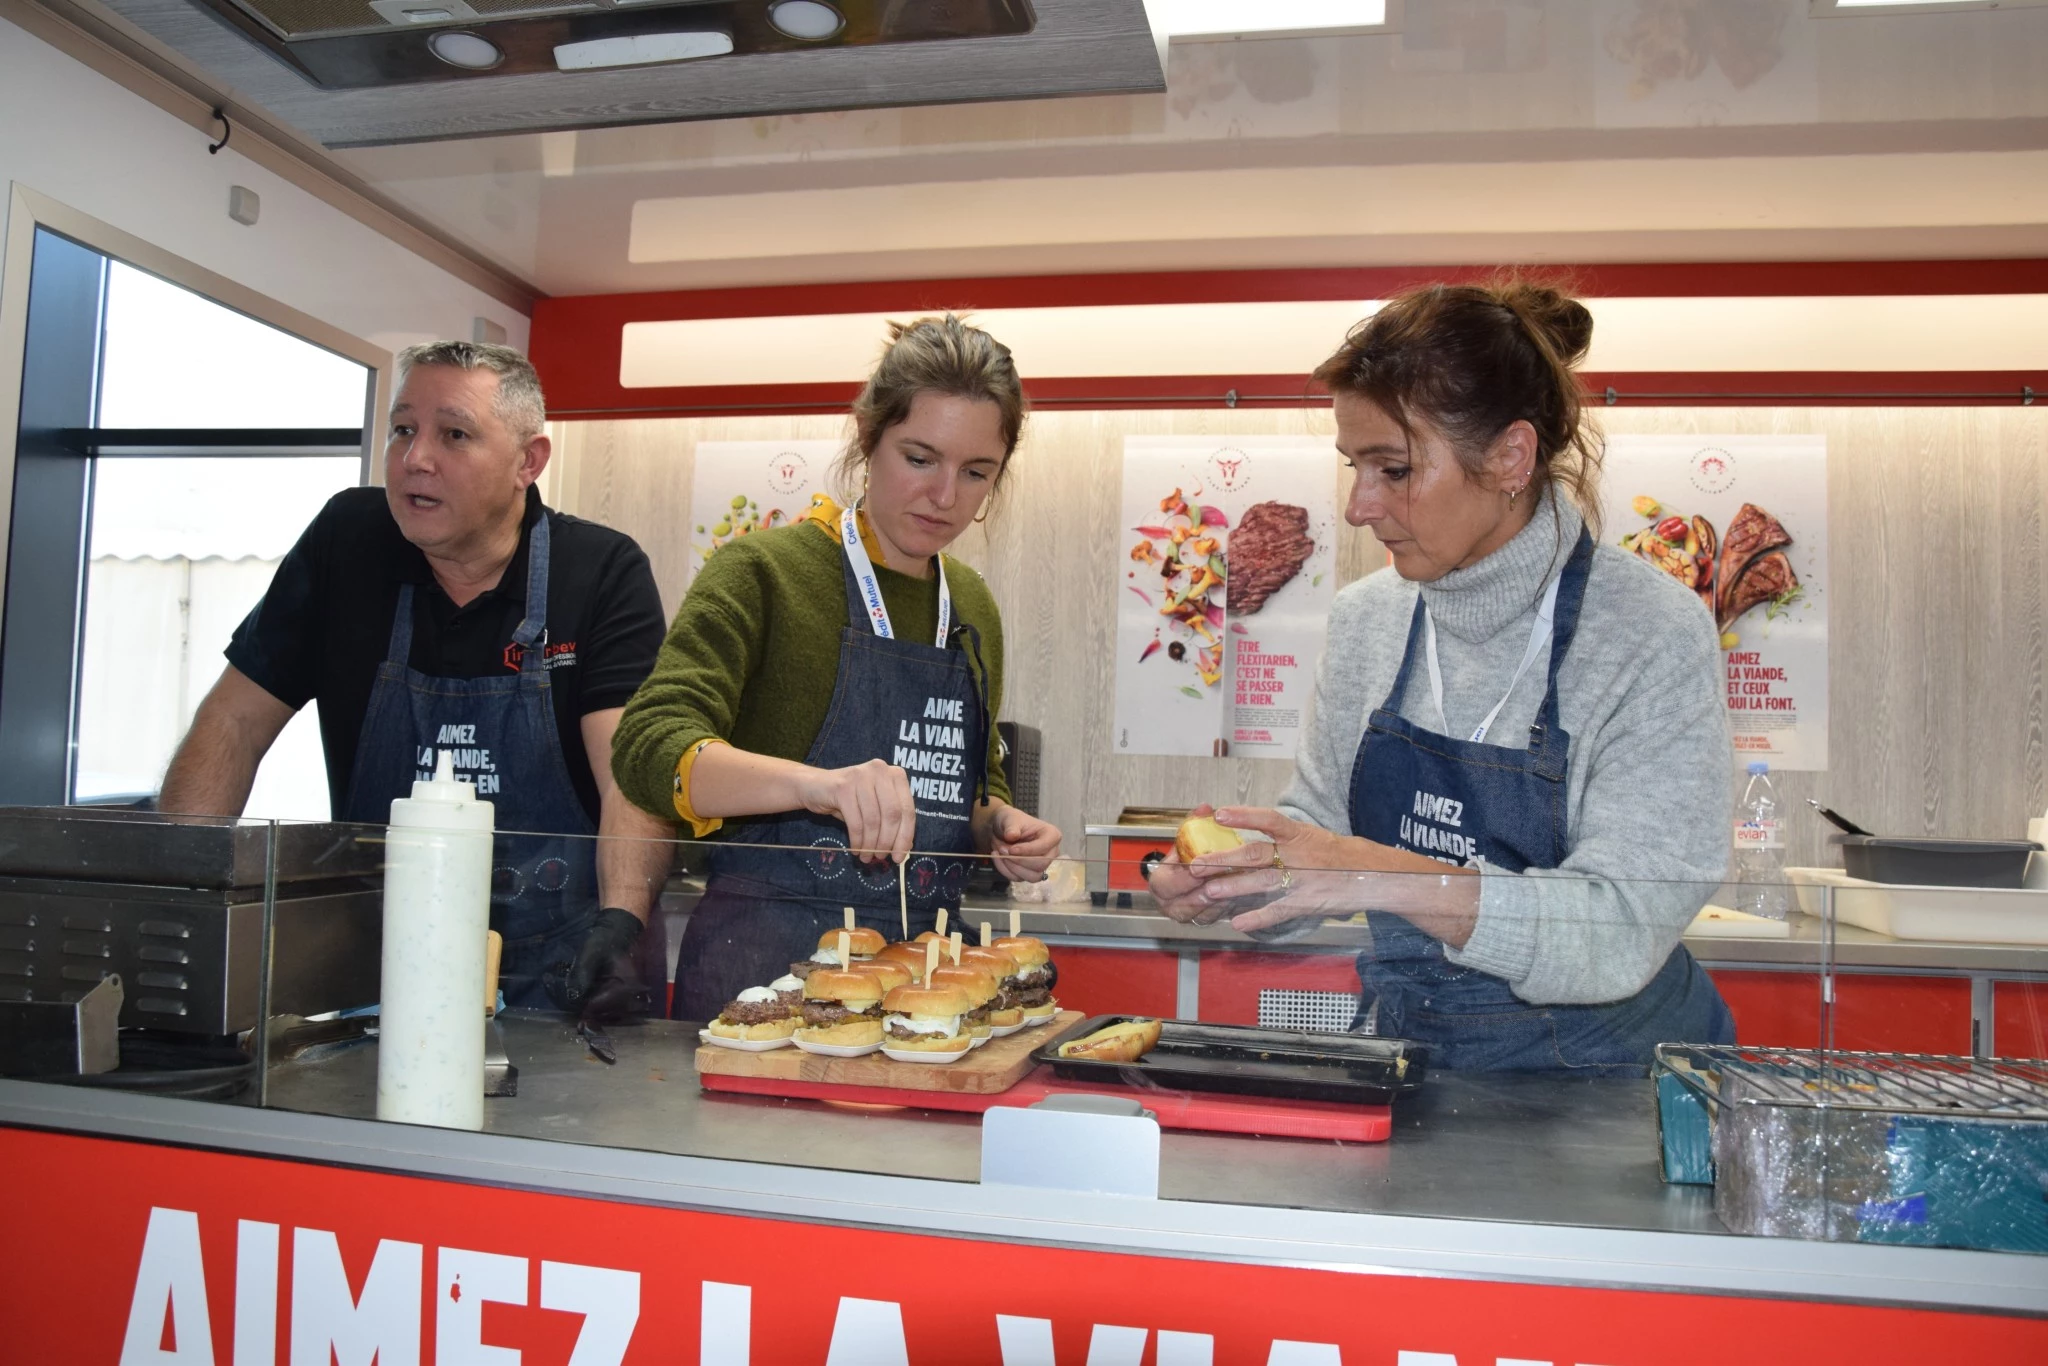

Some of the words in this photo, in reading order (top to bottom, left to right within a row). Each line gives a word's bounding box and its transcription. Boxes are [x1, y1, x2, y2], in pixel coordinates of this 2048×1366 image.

[862, 575, 880, 608] Mutuel
[877, 618, 889, 638] édit
[1236, 654, 1298, 668] FLEXITARIEN,
[1728, 652, 1760, 665] AIMEZ
[1236, 667, 1261, 679] C'EST
[1263, 668, 1276, 679] NE
[1728, 667, 1741, 680] LA
[1743, 667, 1788, 682] VIANDE,
[1236, 680, 1248, 692] SE
[1249, 681, 1284, 692] PASSER
[1728, 682, 1740, 694] ET
[1743, 682, 1770, 695] CEUX
[1235, 693, 1248, 705] DE
[1250, 694, 1275, 706] RIEN.
[1728, 697, 1747, 710] QUI
[1749, 697, 1762, 710] LA
[1765, 697, 1796, 711] FONT.
[923, 697, 964, 722] AIME
[436, 725, 476, 744] AIMEZ
[899, 720, 920, 744] LA
[925, 724, 965, 750] VIAN
[417, 745, 433, 767] LA
[438, 748, 496, 772] ANDE,
[893, 745, 967, 777] MANGEZ-
[910, 776, 964, 803] MIEUX.
[1413, 790, 1464, 827] AIMEZ
[1400, 814, 1412, 843] LA
[1738, 830, 1768, 840] evian
